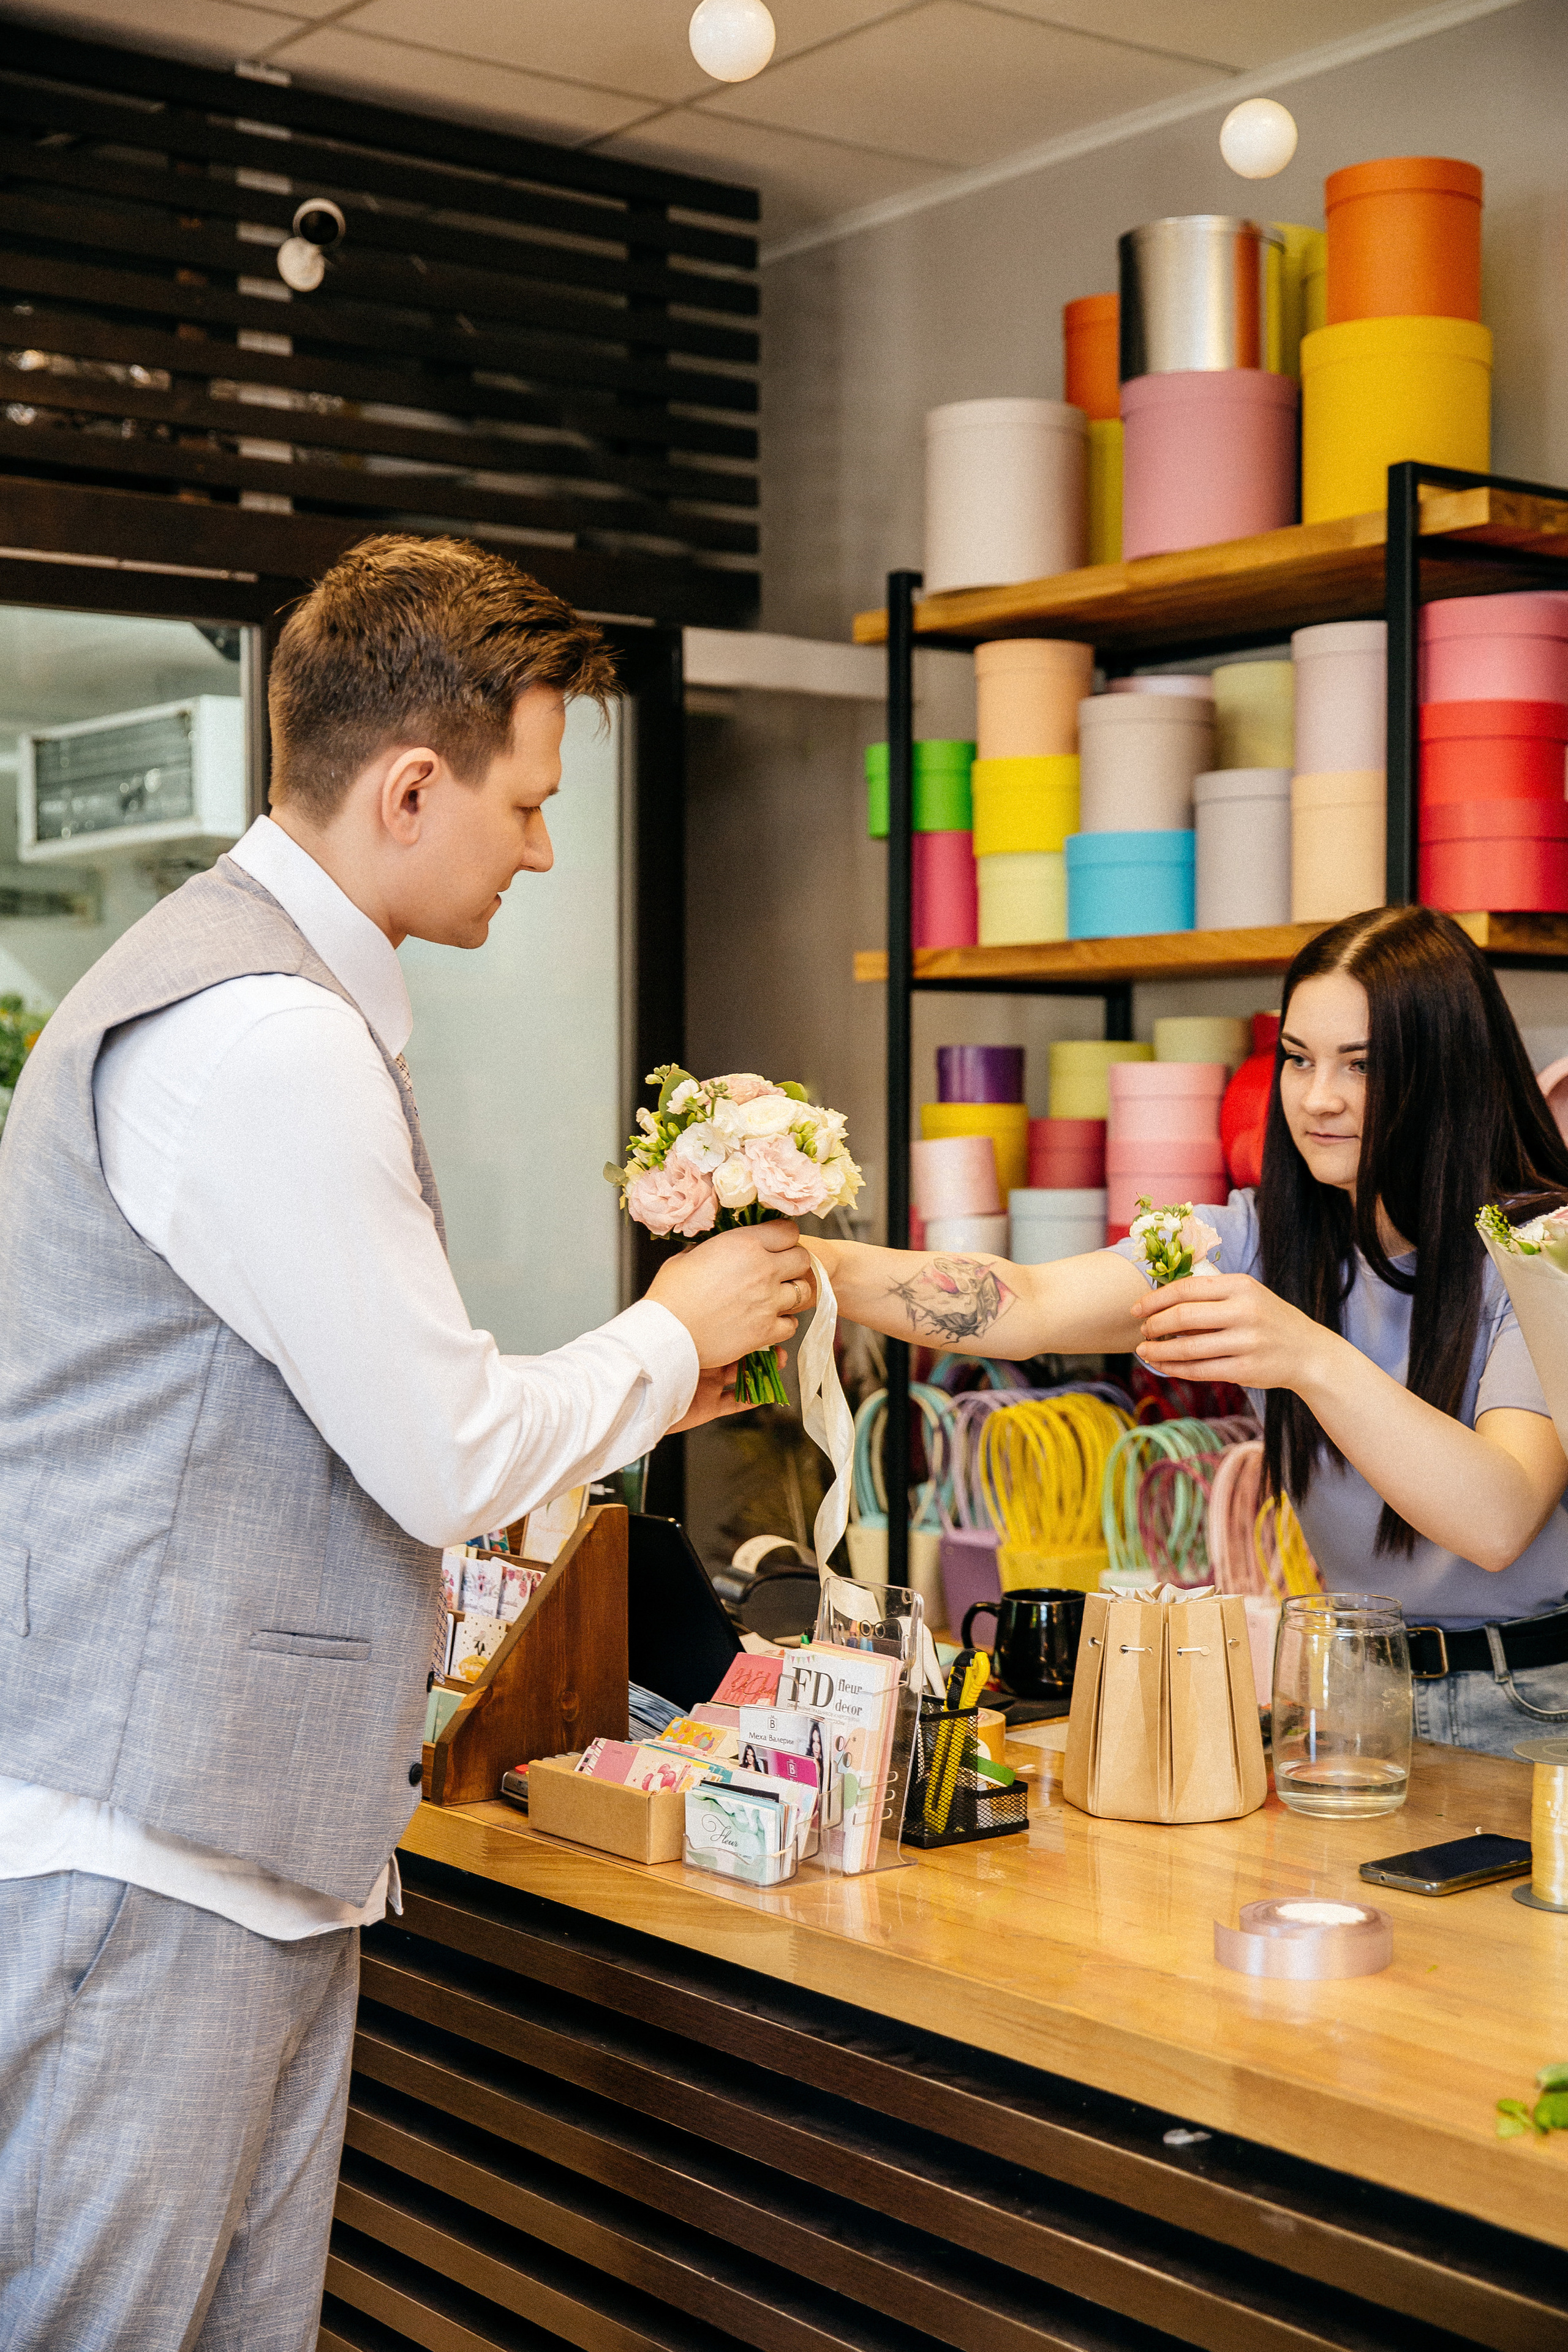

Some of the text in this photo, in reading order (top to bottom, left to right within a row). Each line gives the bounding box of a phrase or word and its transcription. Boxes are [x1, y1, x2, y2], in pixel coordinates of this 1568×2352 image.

[788, 1667, 834, 1708] FD
[837, 1678, 862, 1695] fleur
[835, 1699, 862, 1716] decor
[748, 1732, 794, 1746] Меха Валерии
[701, 1814, 739, 1847] Fleur
